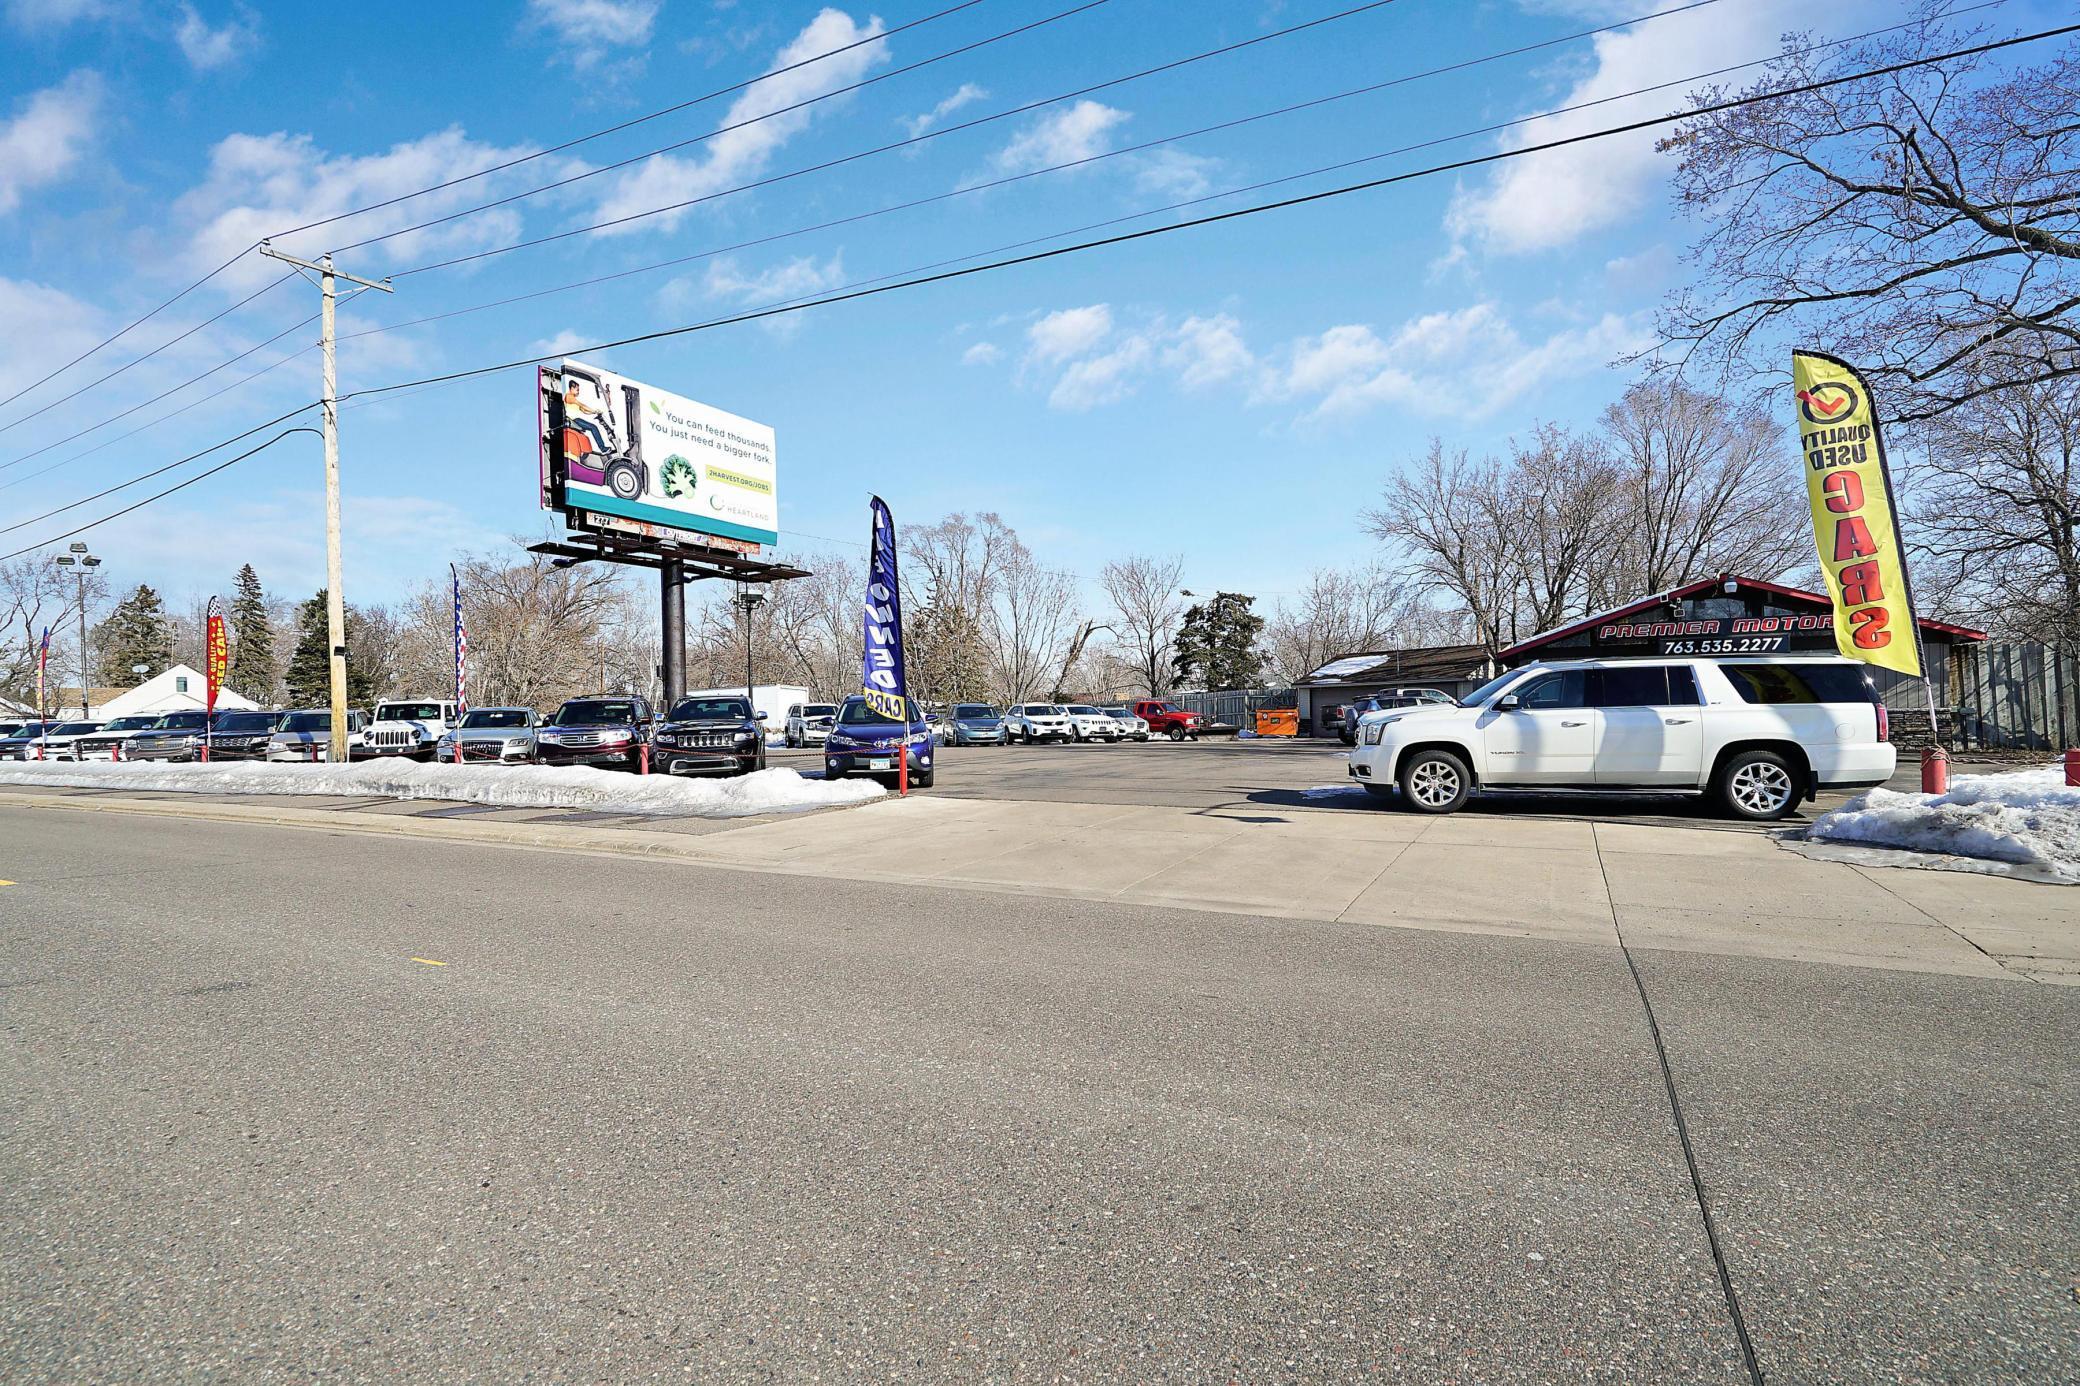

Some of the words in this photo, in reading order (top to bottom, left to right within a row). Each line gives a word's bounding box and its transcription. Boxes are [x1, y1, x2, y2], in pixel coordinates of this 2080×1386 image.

[649, 420, 668, 434] You
[670, 427, 688, 440] just
[691, 434, 714, 448] need
[716, 441, 722, 450] a
[723, 443, 752, 460] bigger
[754, 452, 773, 465] fork.
[665, 411, 684, 426] You
[686, 419, 703, 431] can
[705, 423, 725, 439] feed
[727, 431, 772, 453] thousands.
[709, 469, 770, 491] 2HARVEST.ORG/JOBS
[1600, 620, 1720, 639] PREMIER
[1664, 637, 1782, 655] 763.535.2277
